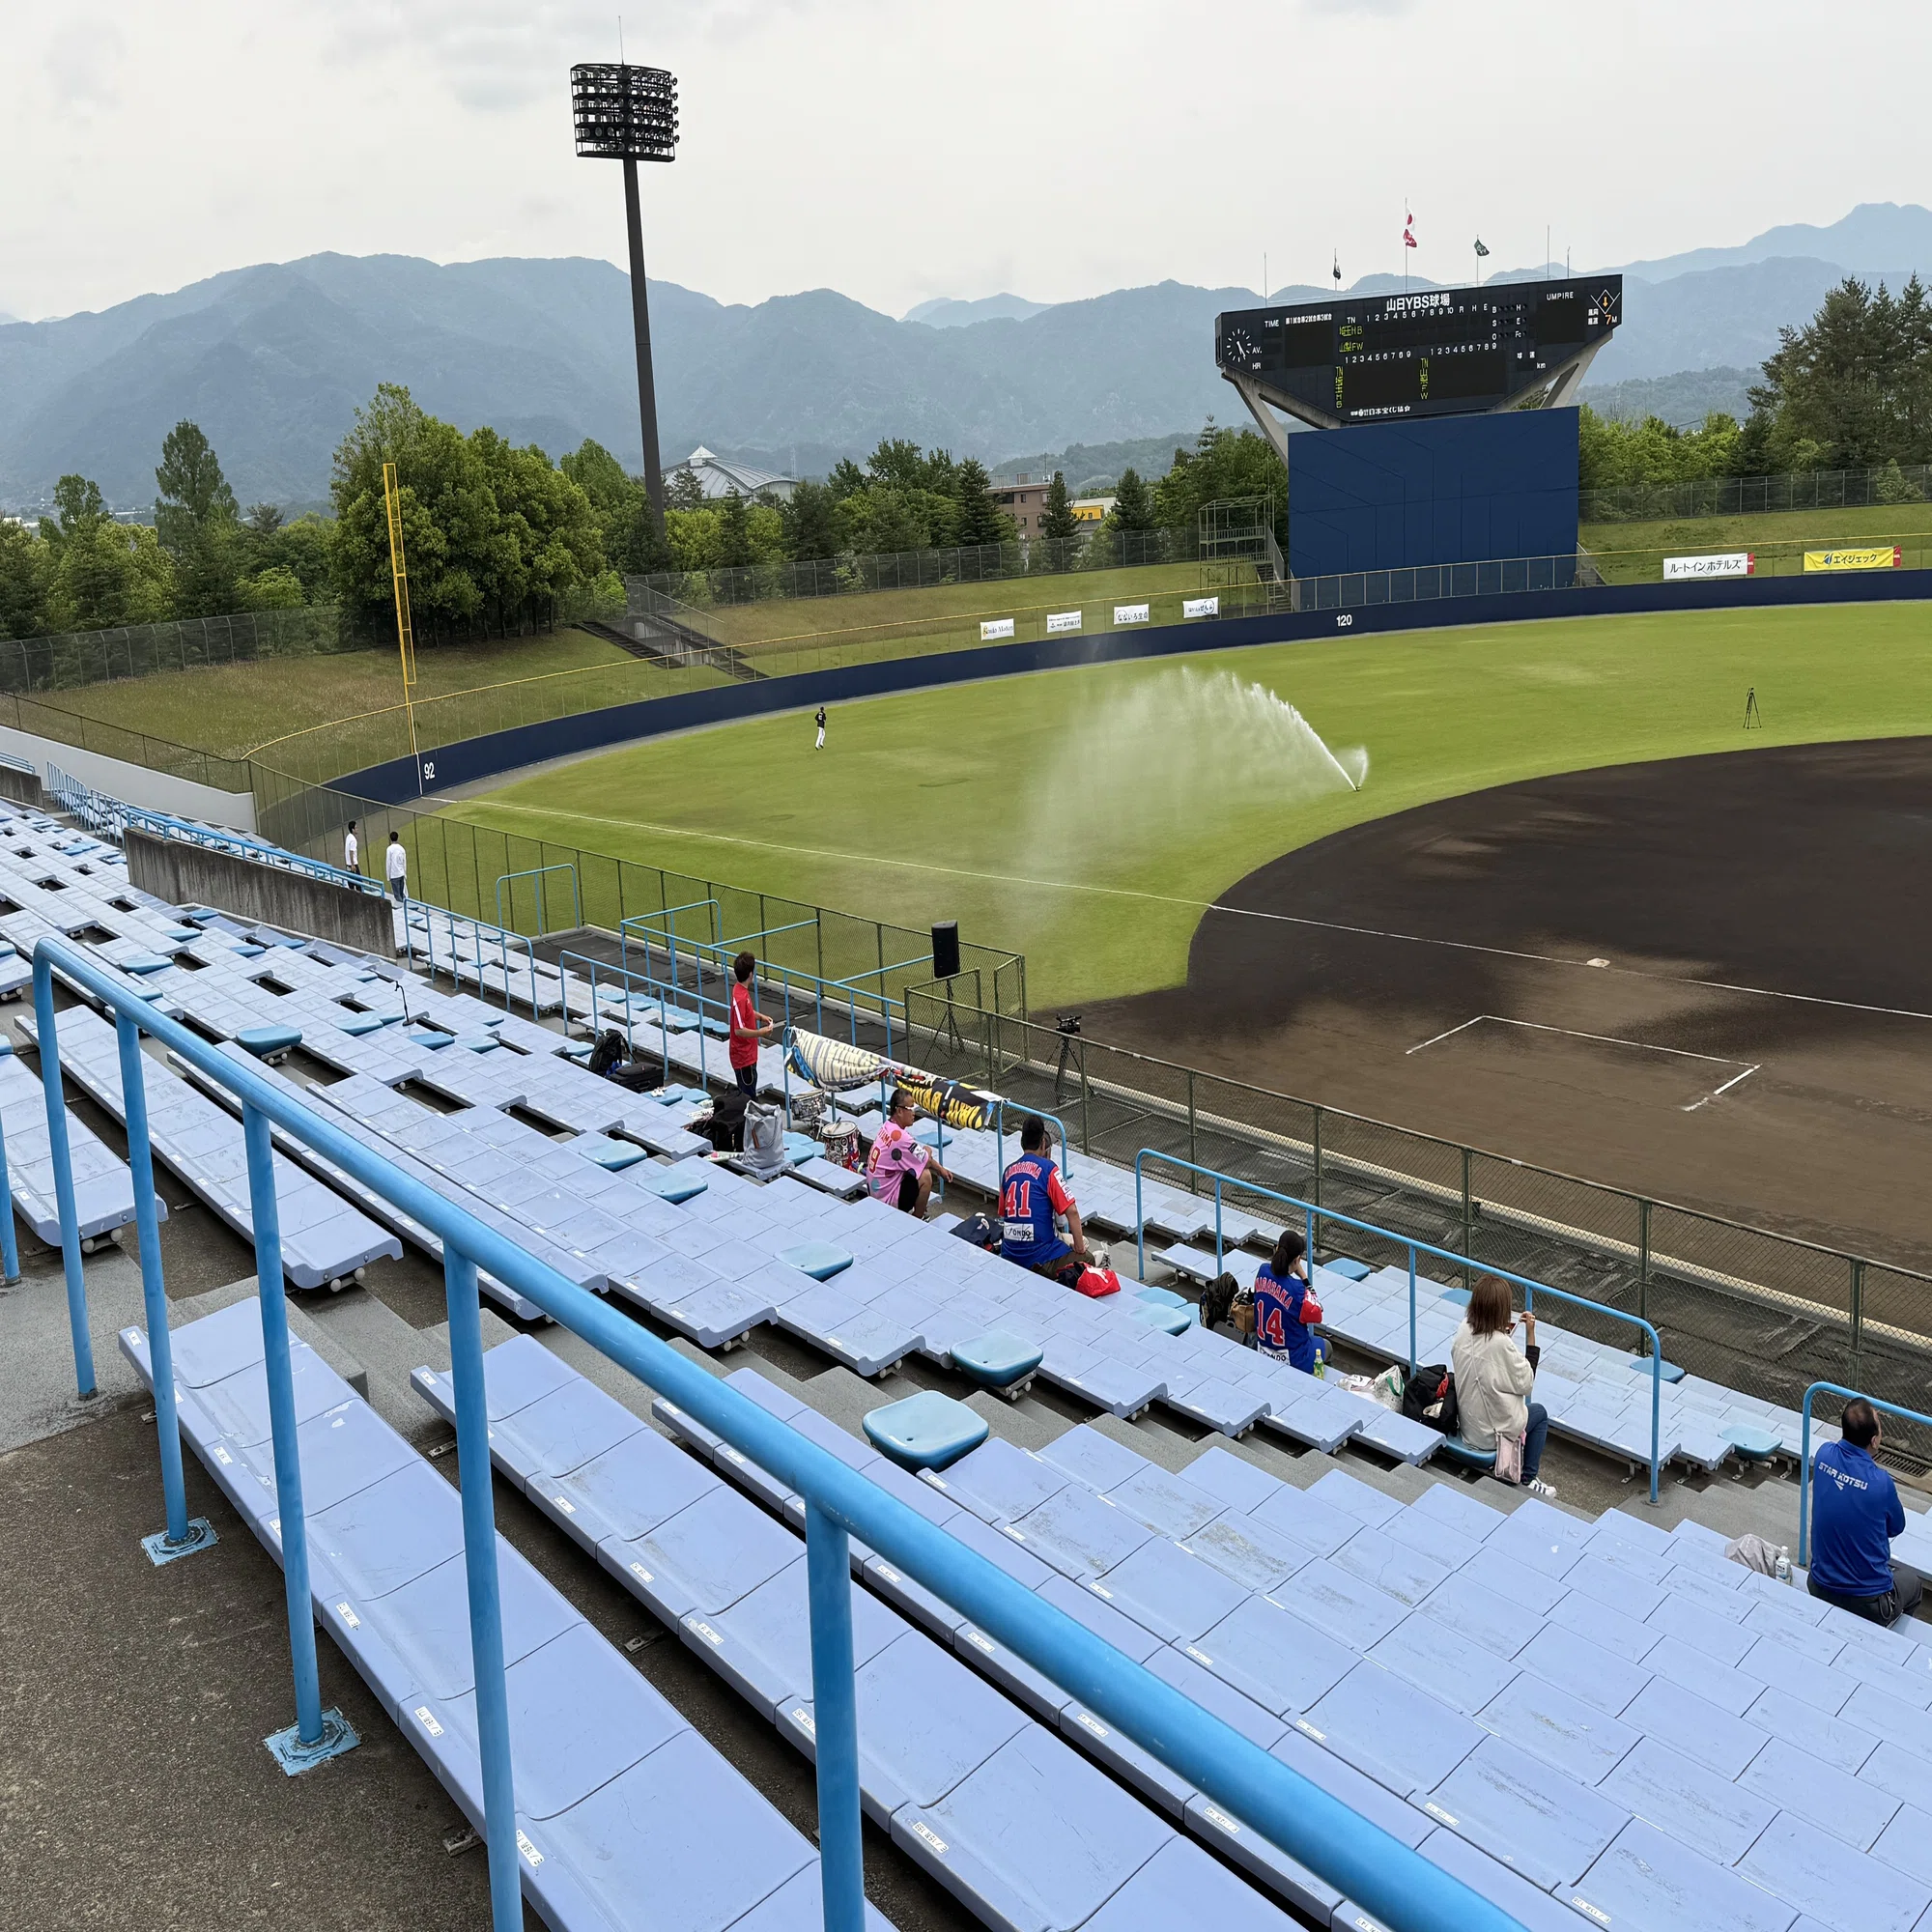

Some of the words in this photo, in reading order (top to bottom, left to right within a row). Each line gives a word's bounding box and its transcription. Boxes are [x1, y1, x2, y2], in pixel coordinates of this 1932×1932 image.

[1386, 293, 1450, 312] 山日YBS球場
[1547, 292, 1574, 300] UMPIRE
[1605, 315, 1611, 325] 7
[1670, 559, 1742, 573] ルートインホテルズ
[1834, 554, 1877, 565] エイジェック
[1336, 614, 1352, 627] 120
[424, 762, 435, 780] 92
[1005, 1180, 1031, 1218] 41
[1257, 1299, 1285, 1346] 14
[1818, 1462, 1838, 1478] STAR
[1837, 1472, 1868, 1490] KOTSU
